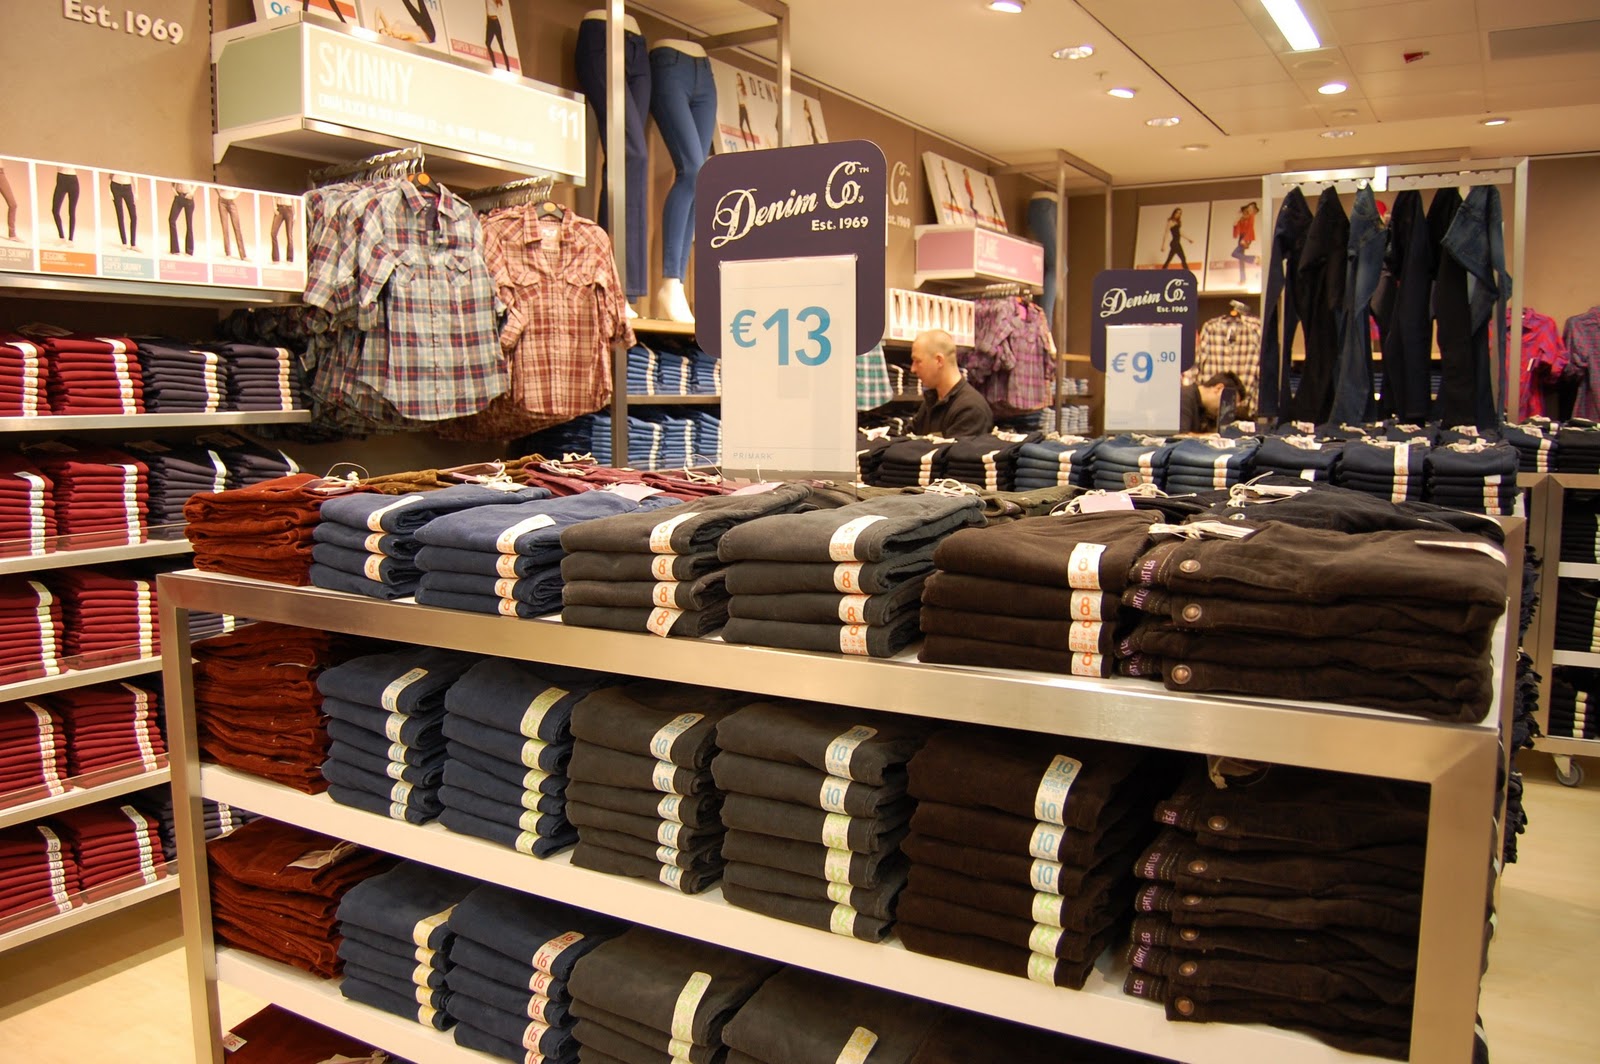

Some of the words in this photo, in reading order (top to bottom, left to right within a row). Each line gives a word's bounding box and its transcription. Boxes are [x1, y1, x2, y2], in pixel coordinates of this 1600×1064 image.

[63, 0, 119, 30] Est.
[125, 10, 184, 45] 1969
[318, 40, 415, 106] SKINNY
[711, 188, 819, 249] Denim
[811, 219, 837, 231] Est.
[839, 216, 869, 229] 1969
[1100, 287, 1161, 318] Denim
[1171, 305, 1189, 313] 1969
[729, 305, 832, 367] €13
[733, 451, 773, 460] PRIMARK
[658, 558, 667, 575] 8
[842, 571, 851, 589] 8
[500, 581, 508, 597] 8
[659, 586, 668, 603] 8
[847, 606, 857, 622] 8
[1080, 596, 1091, 616] 8
[656, 610, 670, 626] 8
[655, 737, 669, 755] 10
[830, 744, 848, 762] 10
[1055, 759, 1075, 775] 10
[657, 776, 671, 792] 10
[663, 796, 677, 813] 10
[825, 786, 841, 806] 10
[1040, 801, 1057, 821] 10
[663, 823, 676, 841] 10
[1036, 831, 1055, 854] 10
[664, 865, 679, 882] 10
[1037, 864, 1054, 885] 10
[535, 951, 551, 969] 16
[533, 974, 548, 990] 16
[1133, 979, 1144, 995] LEG
[531, 999, 544, 1015] 16
[527, 1026, 540, 1043] 16
